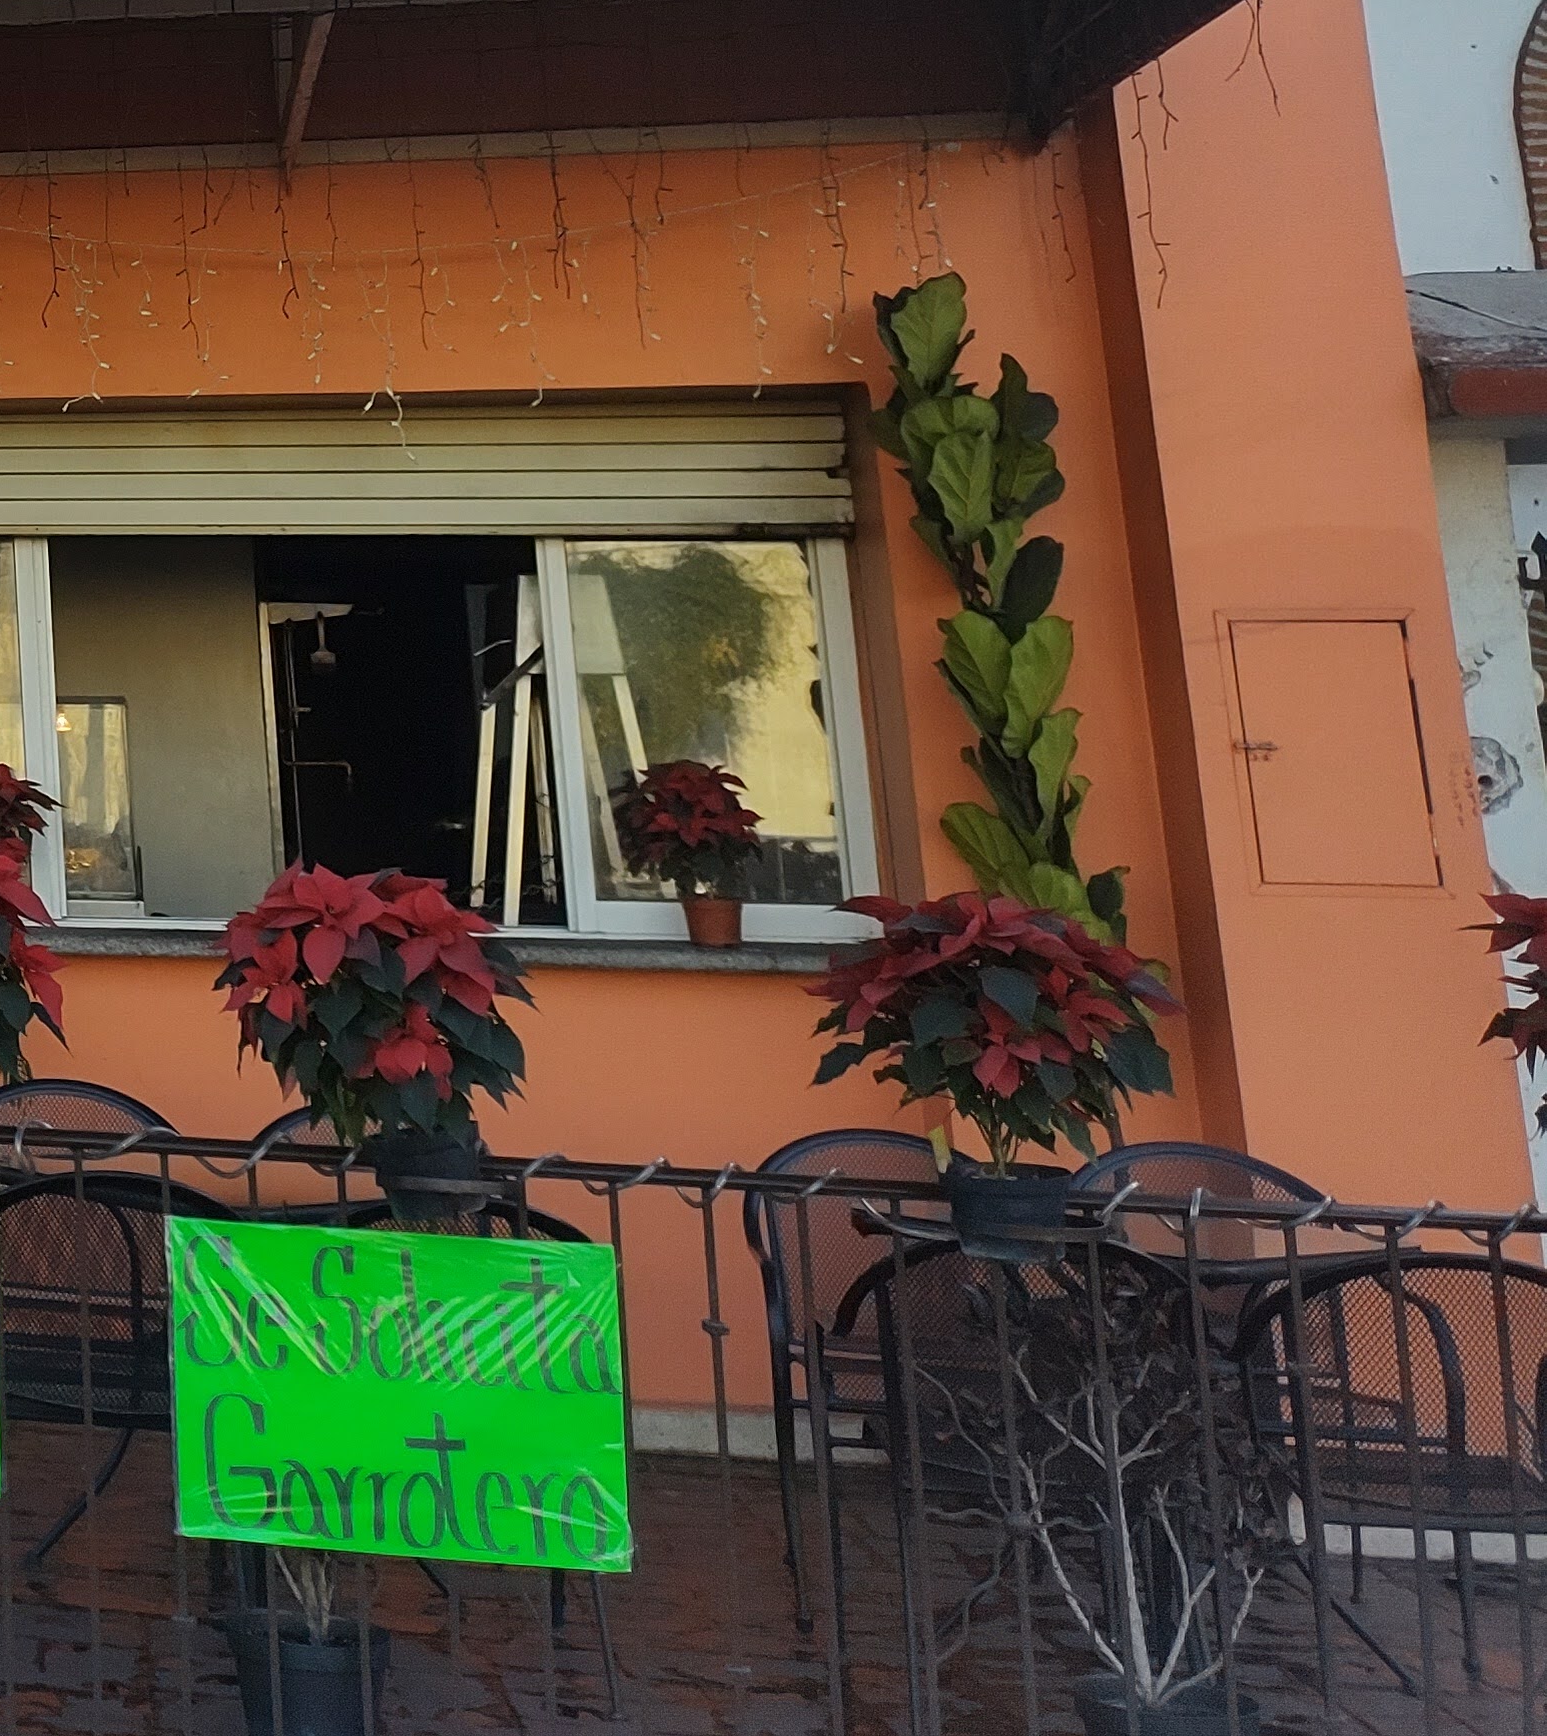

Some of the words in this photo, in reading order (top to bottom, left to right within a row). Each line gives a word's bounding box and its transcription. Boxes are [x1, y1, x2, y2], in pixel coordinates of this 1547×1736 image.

[176, 1234, 289, 1371] Se
[311, 1244, 623, 1396] Solicita
[203, 1393, 609, 1562] Garrotero
